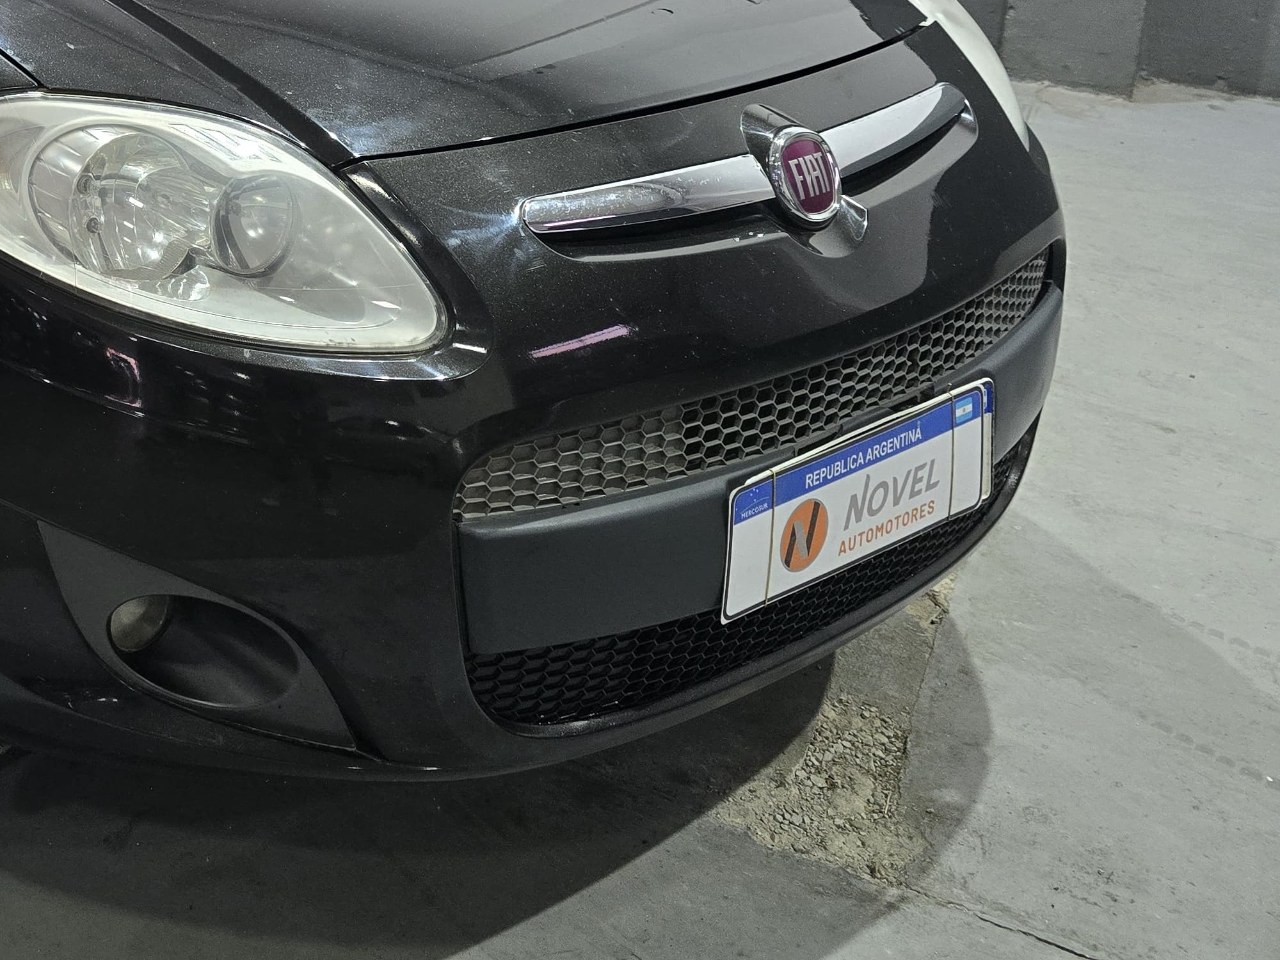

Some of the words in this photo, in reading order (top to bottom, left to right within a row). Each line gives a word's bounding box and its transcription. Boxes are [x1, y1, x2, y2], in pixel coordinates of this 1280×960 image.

[788, 152, 830, 200] FIAT
[805, 454, 864, 489] REPUBLICA
[866, 428, 922, 461] ARGENTINA
[740, 502, 768, 519] MERCOSUR
[843, 458, 940, 531] NOVEL
[838, 500, 936, 556] AUTOMOTORES
